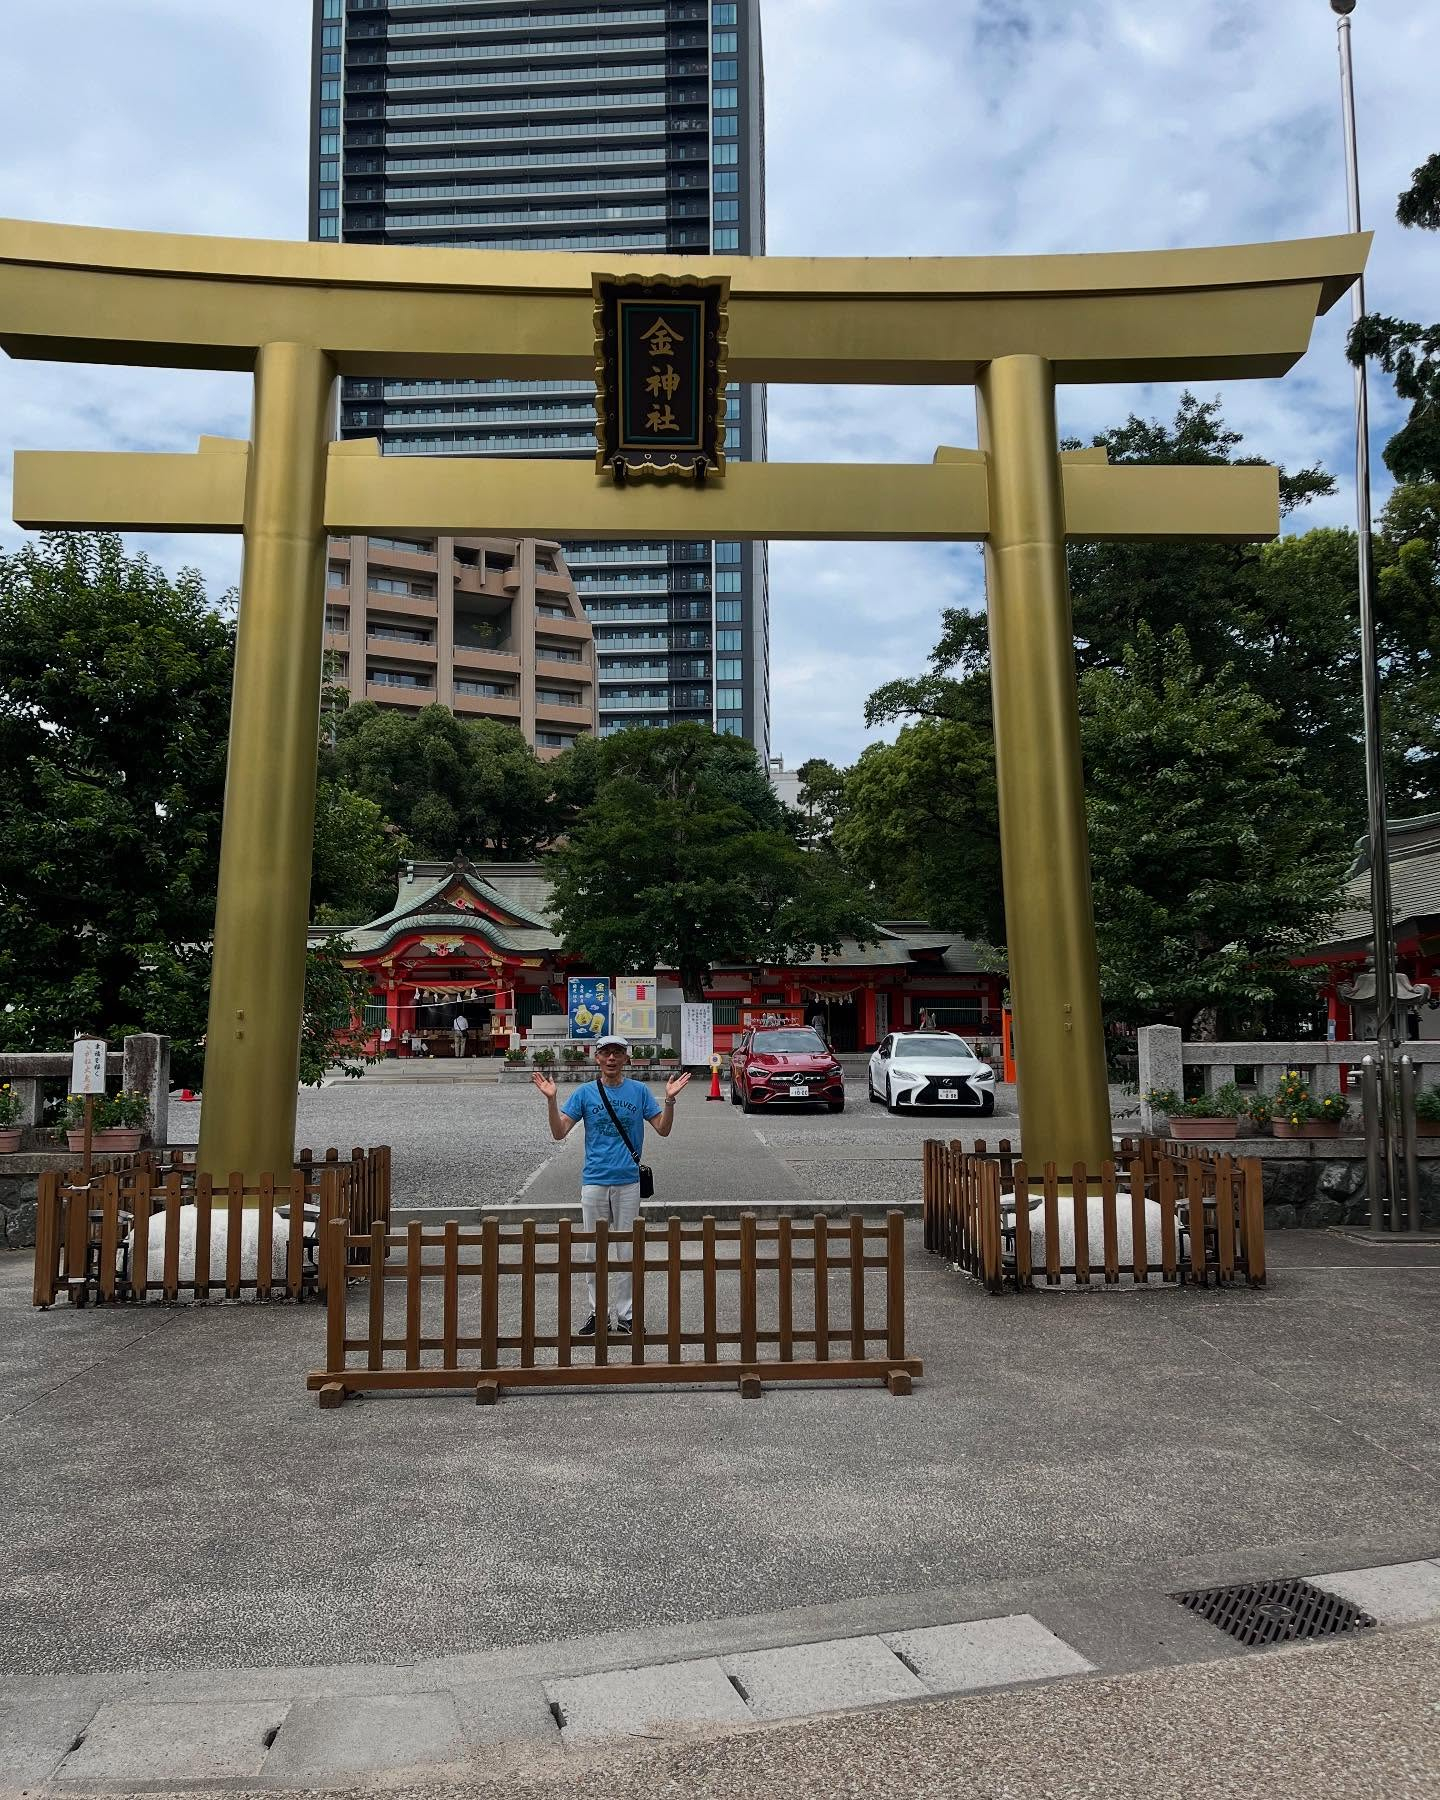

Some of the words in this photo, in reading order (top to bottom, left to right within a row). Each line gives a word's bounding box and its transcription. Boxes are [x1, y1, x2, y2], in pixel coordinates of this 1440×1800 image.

[639, 316, 685, 433] 金神社
[592, 1099, 637, 1115] QUSILVER
